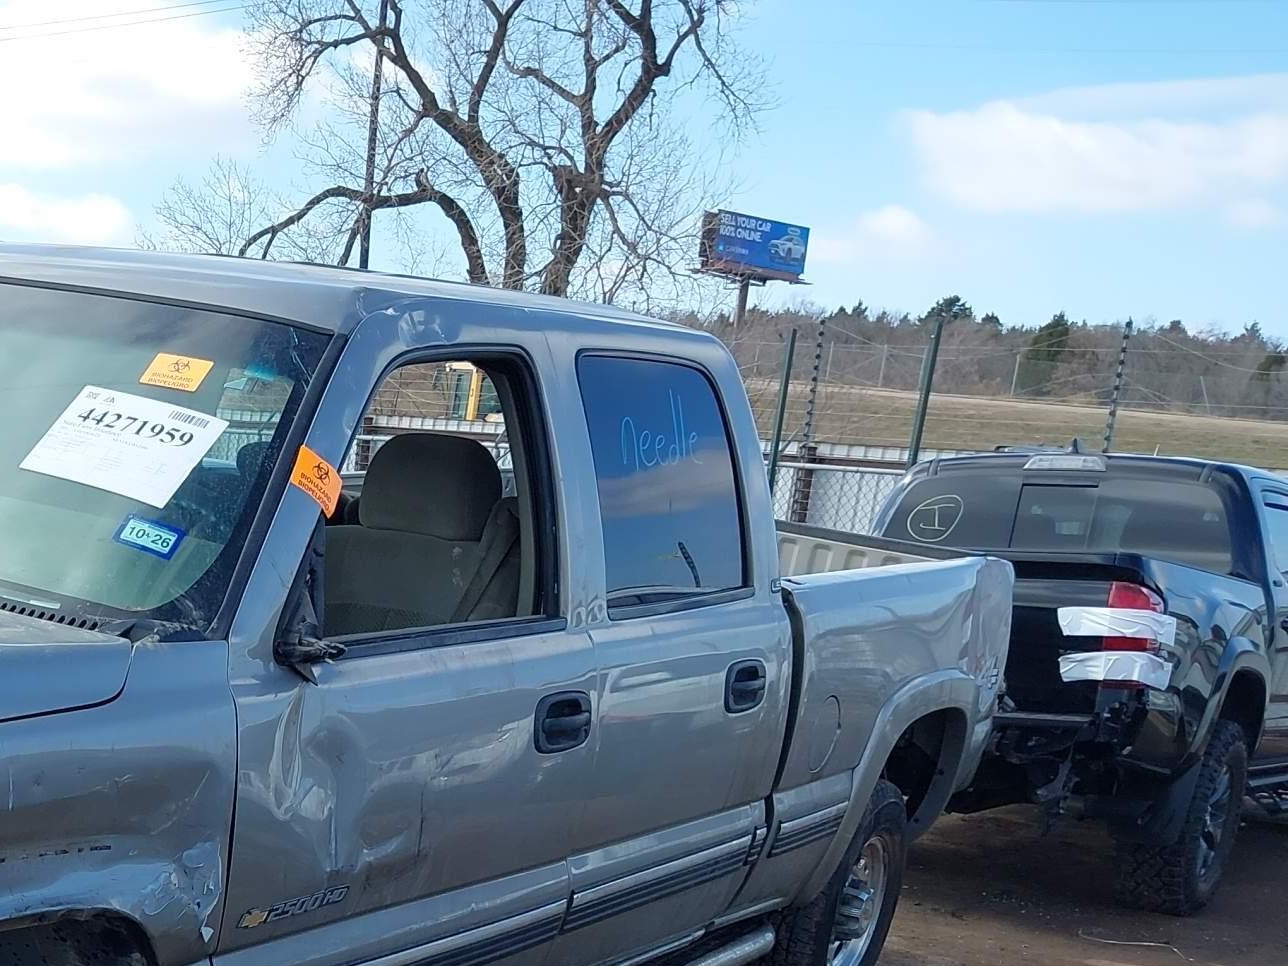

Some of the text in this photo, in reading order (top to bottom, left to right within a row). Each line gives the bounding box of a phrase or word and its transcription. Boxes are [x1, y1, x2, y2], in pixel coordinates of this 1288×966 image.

[720, 213, 736, 225] SELL
[737, 216, 756, 229] YOUR
[757, 220, 772, 233] CAR
[737, 228, 763, 242] ONLINE
[152, 371, 193, 384] BIOHAZARD
[77, 407, 194, 448] 44271959
[297, 479, 330, 512] BIOPELIGRO
[300, 472, 332, 503] BIOHAZARD
[128, 526, 172, 549] 10 26
